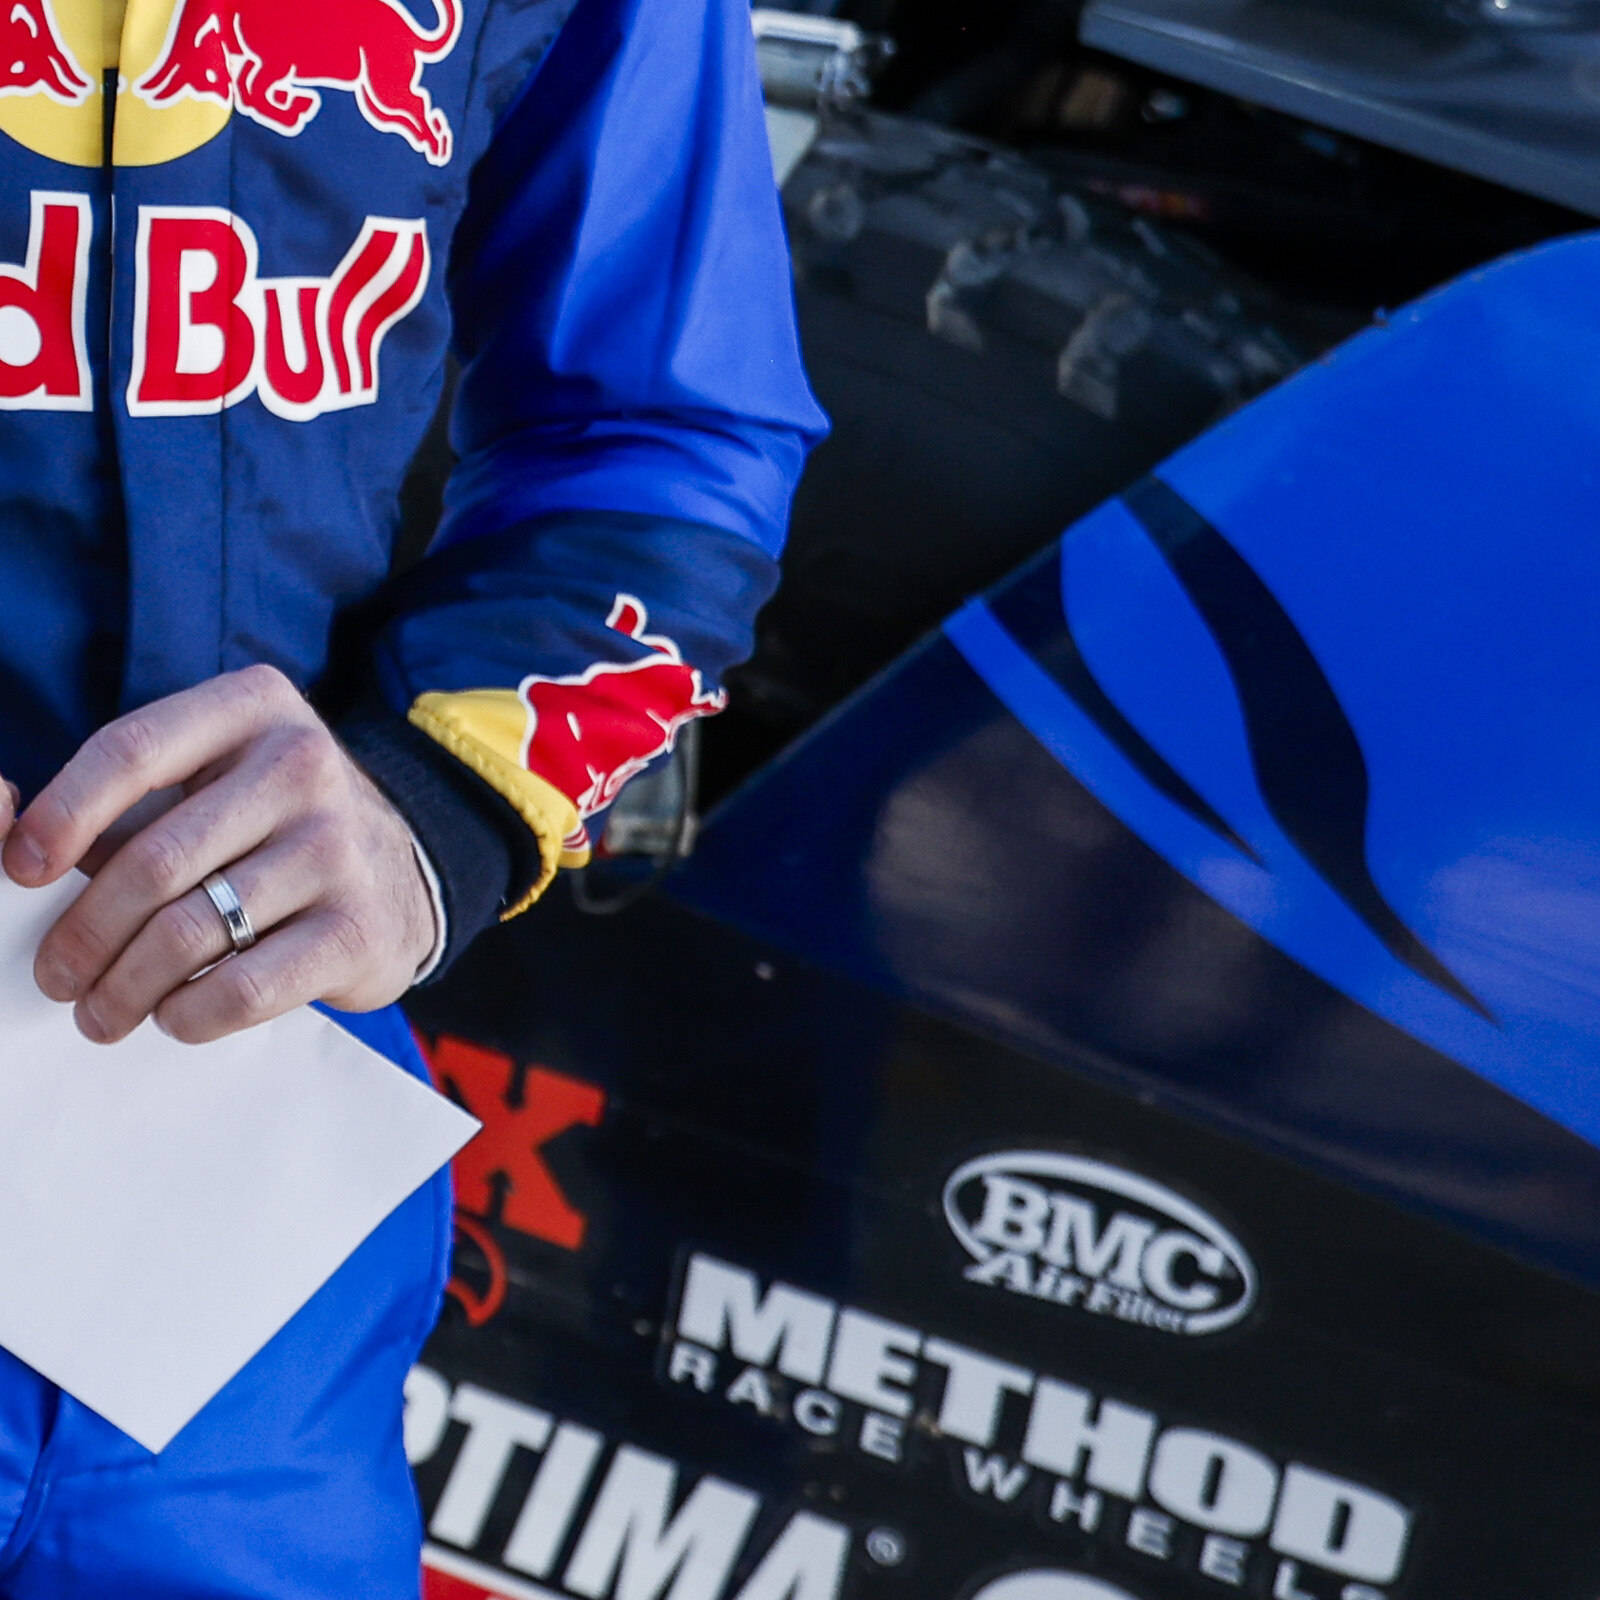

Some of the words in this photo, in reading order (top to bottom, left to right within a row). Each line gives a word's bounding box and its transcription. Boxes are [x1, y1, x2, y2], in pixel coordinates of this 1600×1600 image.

[131, 211, 429, 414] Bull
[962, 1250, 1086, 1306] Air
[1082, 1282, 1190, 1334] Filter
[968, 1172, 1226, 1311] BMC
[668, 1343, 906, 1463] RACE
[679, 1252, 1414, 1585] METHOD
